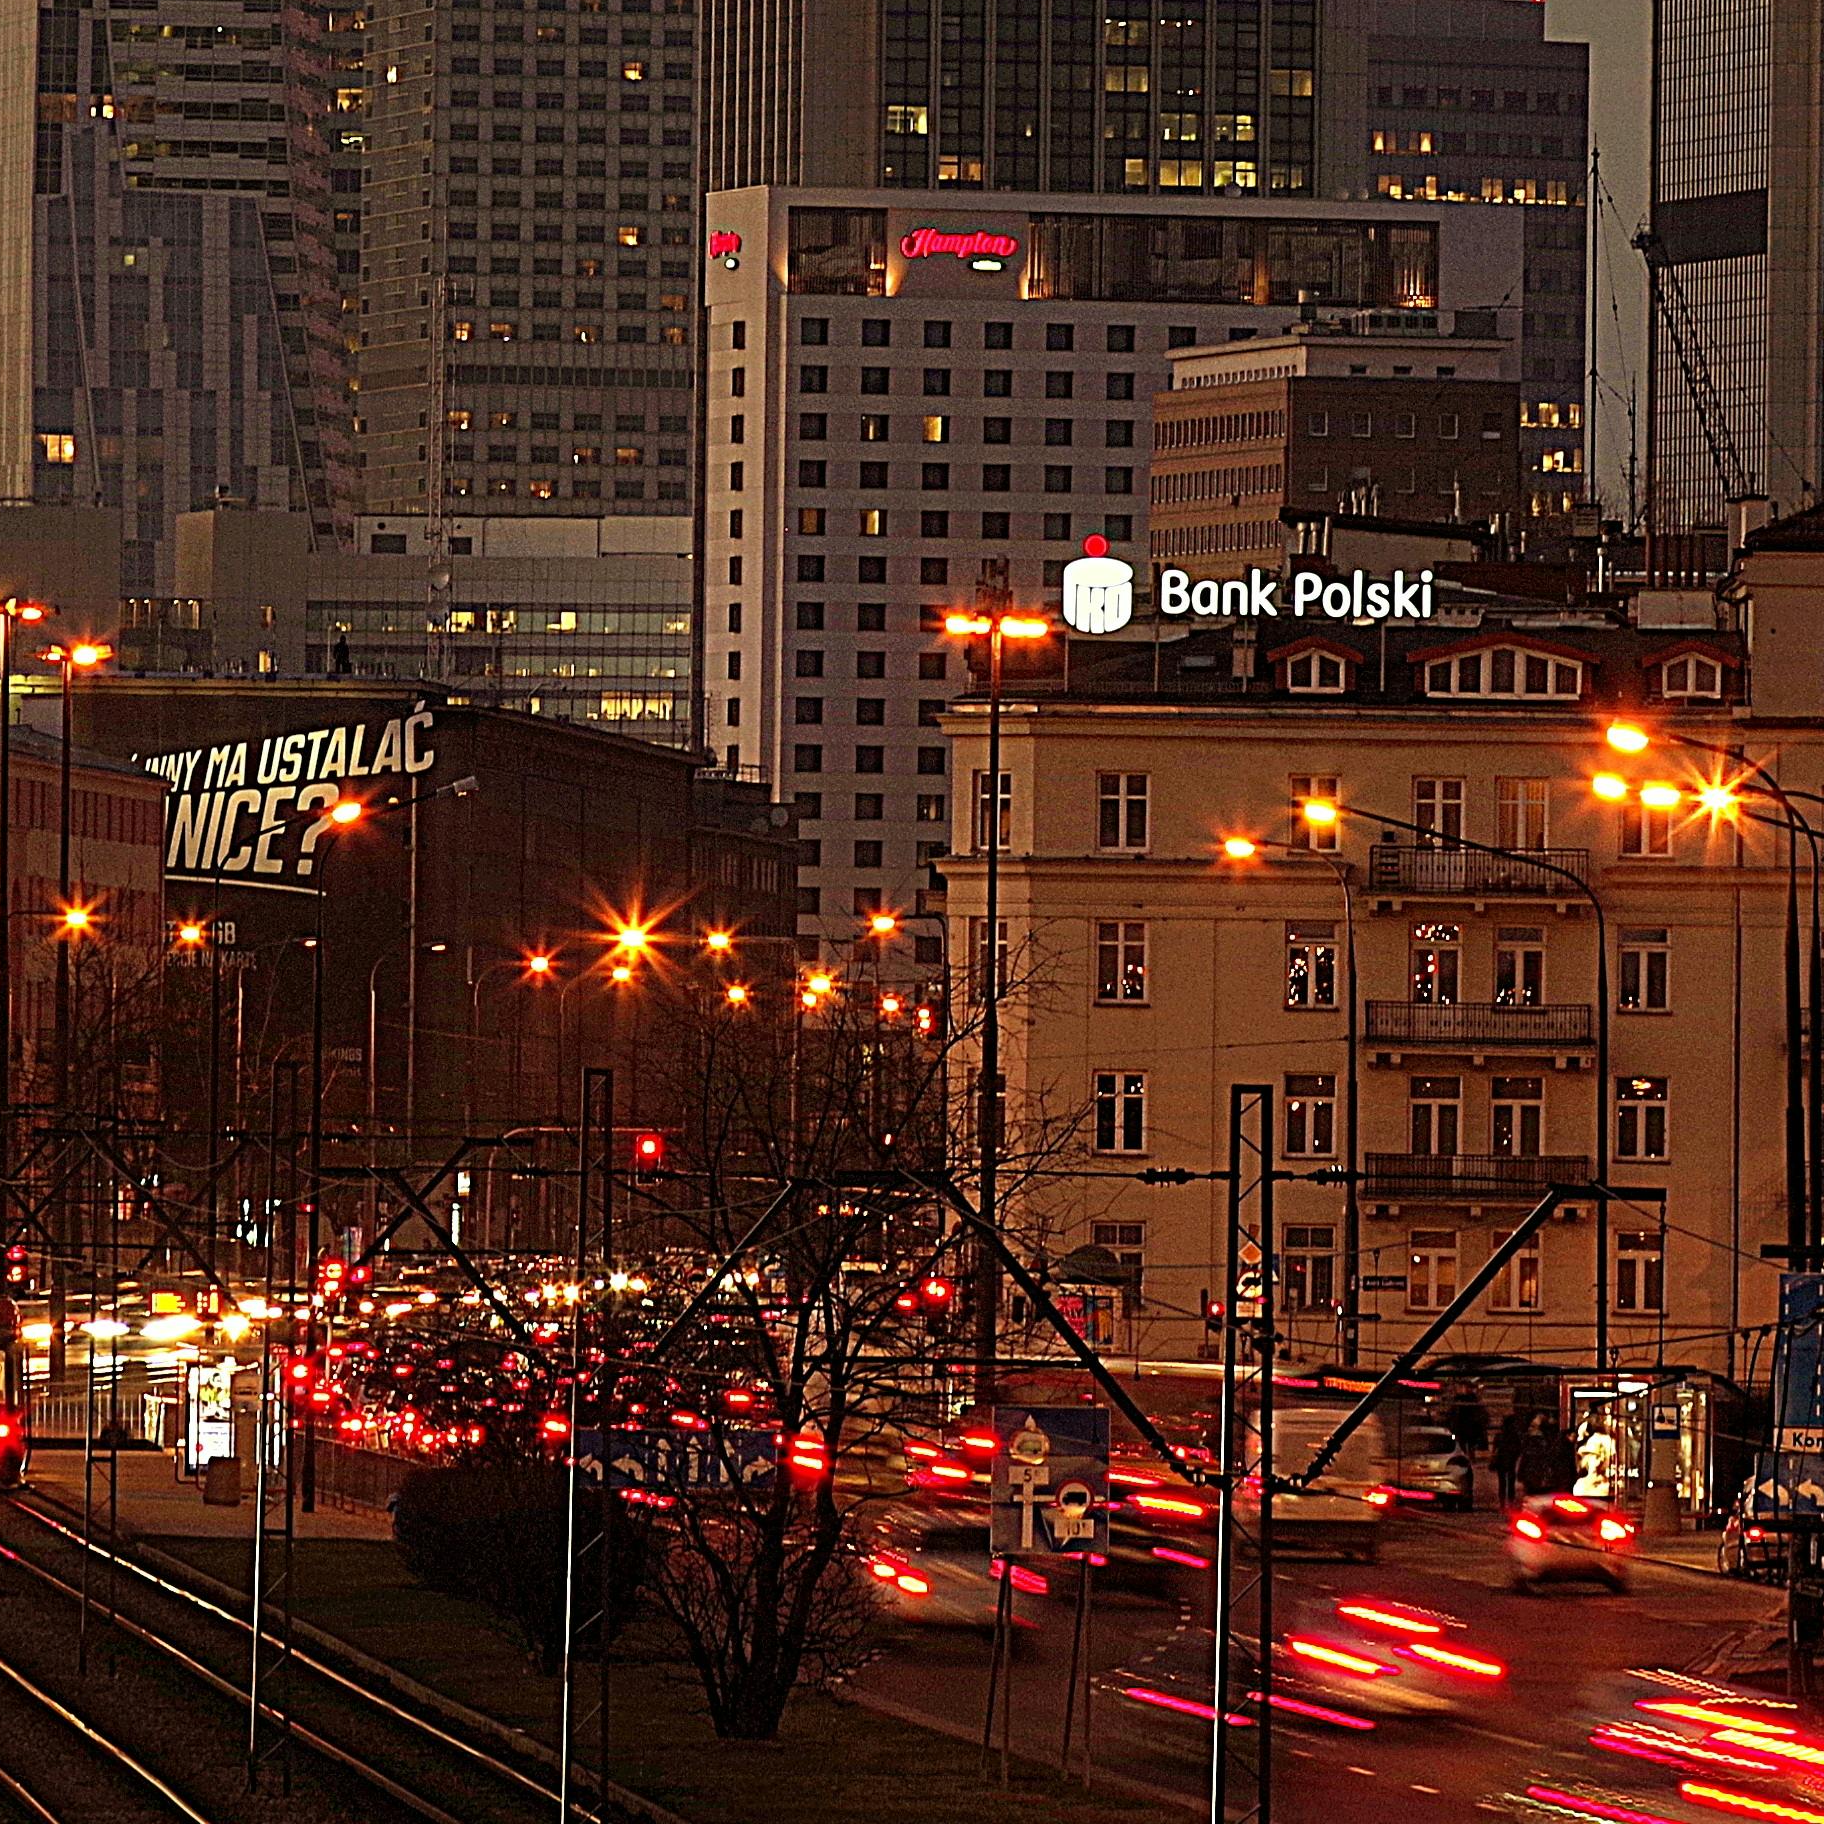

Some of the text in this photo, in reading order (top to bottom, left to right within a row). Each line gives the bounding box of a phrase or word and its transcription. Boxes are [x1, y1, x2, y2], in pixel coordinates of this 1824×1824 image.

[900, 228, 1019, 258] Hampton
[1160, 567, 1278, 617] Bank
[1294, 568, 1435, 619] Polski
[204, 742, 248, 789] MA
[256, 699, 435, 784] USTALAĆ
